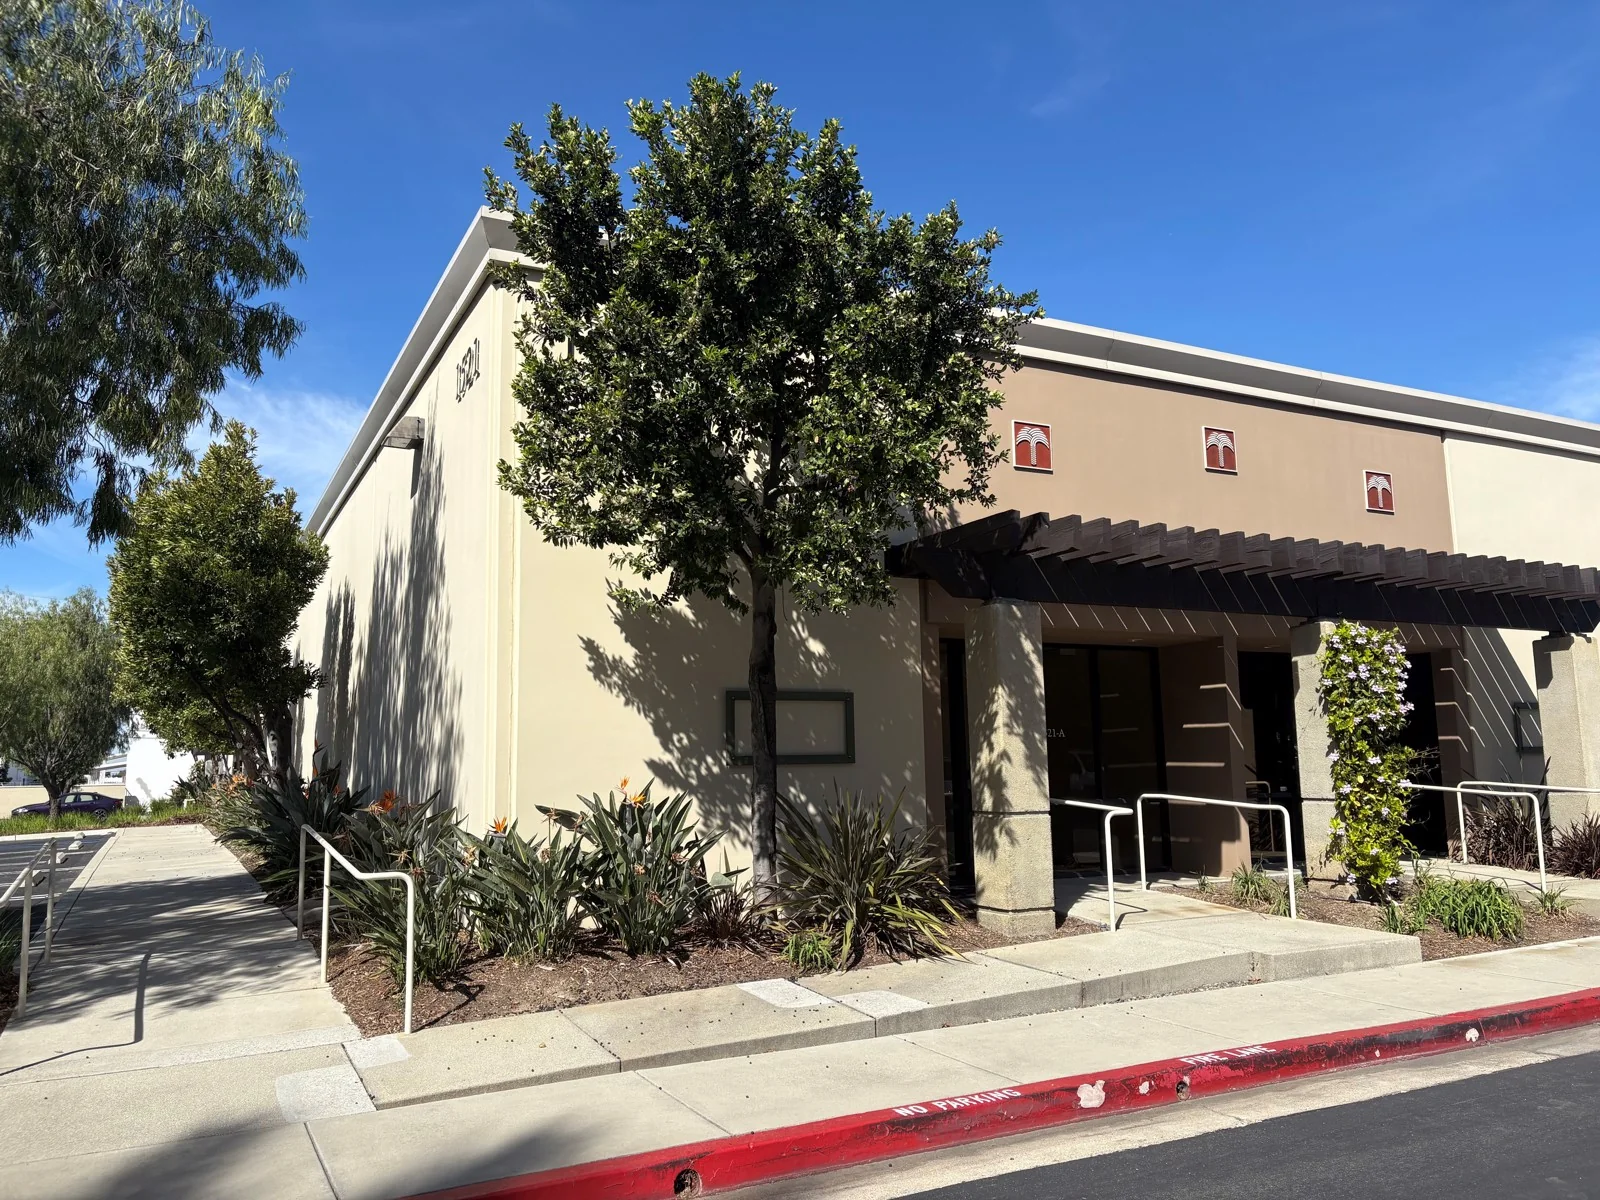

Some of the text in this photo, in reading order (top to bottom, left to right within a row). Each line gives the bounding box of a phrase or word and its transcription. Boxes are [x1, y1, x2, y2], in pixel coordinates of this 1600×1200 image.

[1046, 728, 1066, 738] 21-A
[1179, 1045, 1277, 1065] FIRE LANE
[893, 1089, 1022, 1117] NO PARKING
